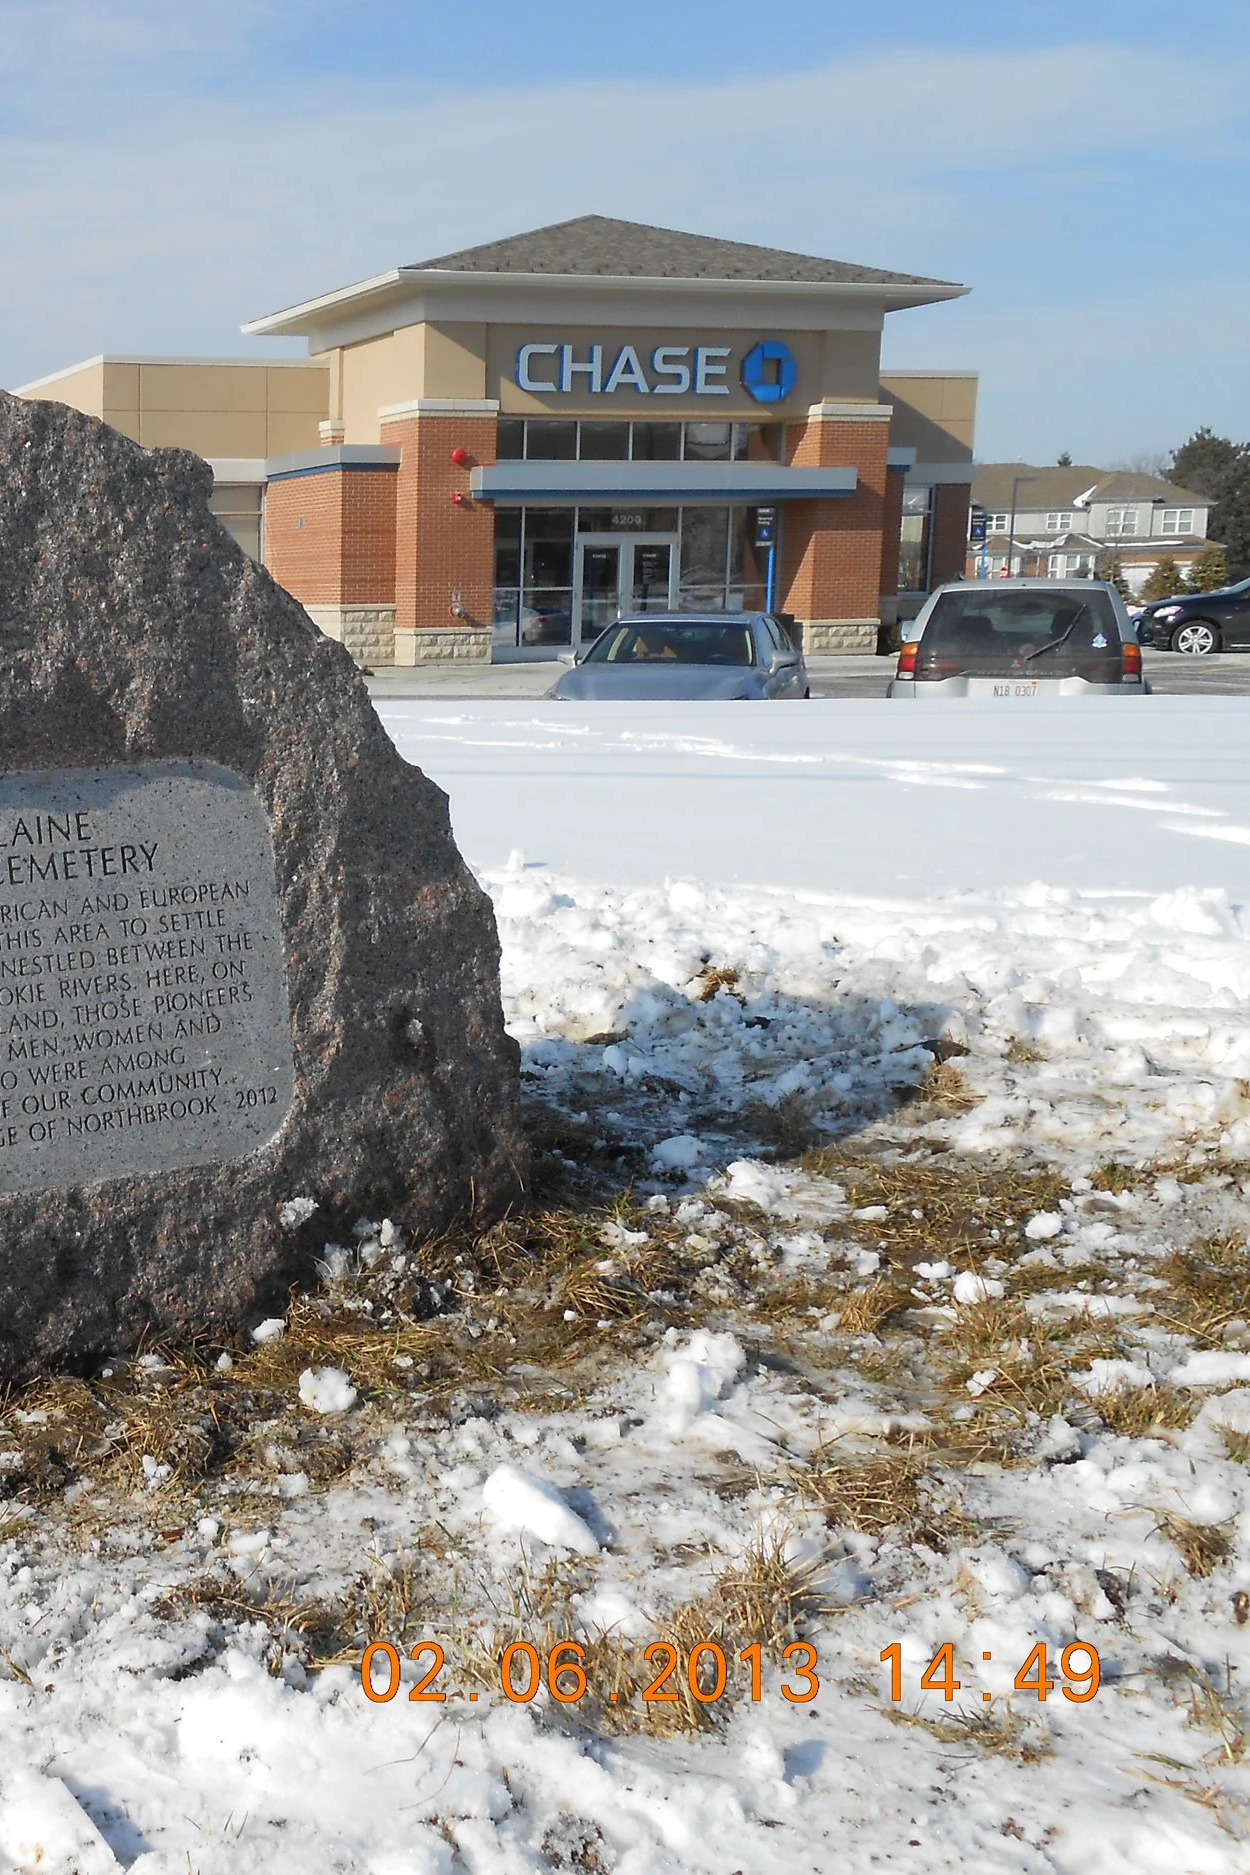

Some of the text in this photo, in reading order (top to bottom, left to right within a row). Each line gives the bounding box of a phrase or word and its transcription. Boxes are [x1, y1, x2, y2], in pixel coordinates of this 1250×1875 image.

[516, 343, 732, 394] CHASE
[81, 893, 129, 915] AND
[139, 880, 250, 909] EUROPEAN
[54, 922, 110, 945] AREA
[120, 917, 147, 937] TO
[159, 908, 227, 933] SETTLE
[1, 951, 96, 978] NESTLED
[107, 937, 205, 966] BETWEEN
[215, 932, 254, 952] THE
[60, 973, 137, 999] RIVERS.
[146, 965, 205, 988] HERE,
[212, 960, 246, 979] ON
[72, 999, 143, 1025] THOSE
[154, 985, 252, 1014] PIONEERS
[8, 1037, 66, 1061] MEN,
[73, 1023, 163, 1051] WOMEN
[174, 1013, 222, 1039] AND
[28, 1059, 88, 1086] WERE
[101, 1047, 185, 1075] AMONG
[22, 1090, 71, 1115] OUR
[81, 1068, 229, 1105] COMMUNITY.
[28, 1119, 56, 1141] OF
[66, 1095, 218, 1136] NORTHBROOK
[235, 1086, 278, 1109] 2012
